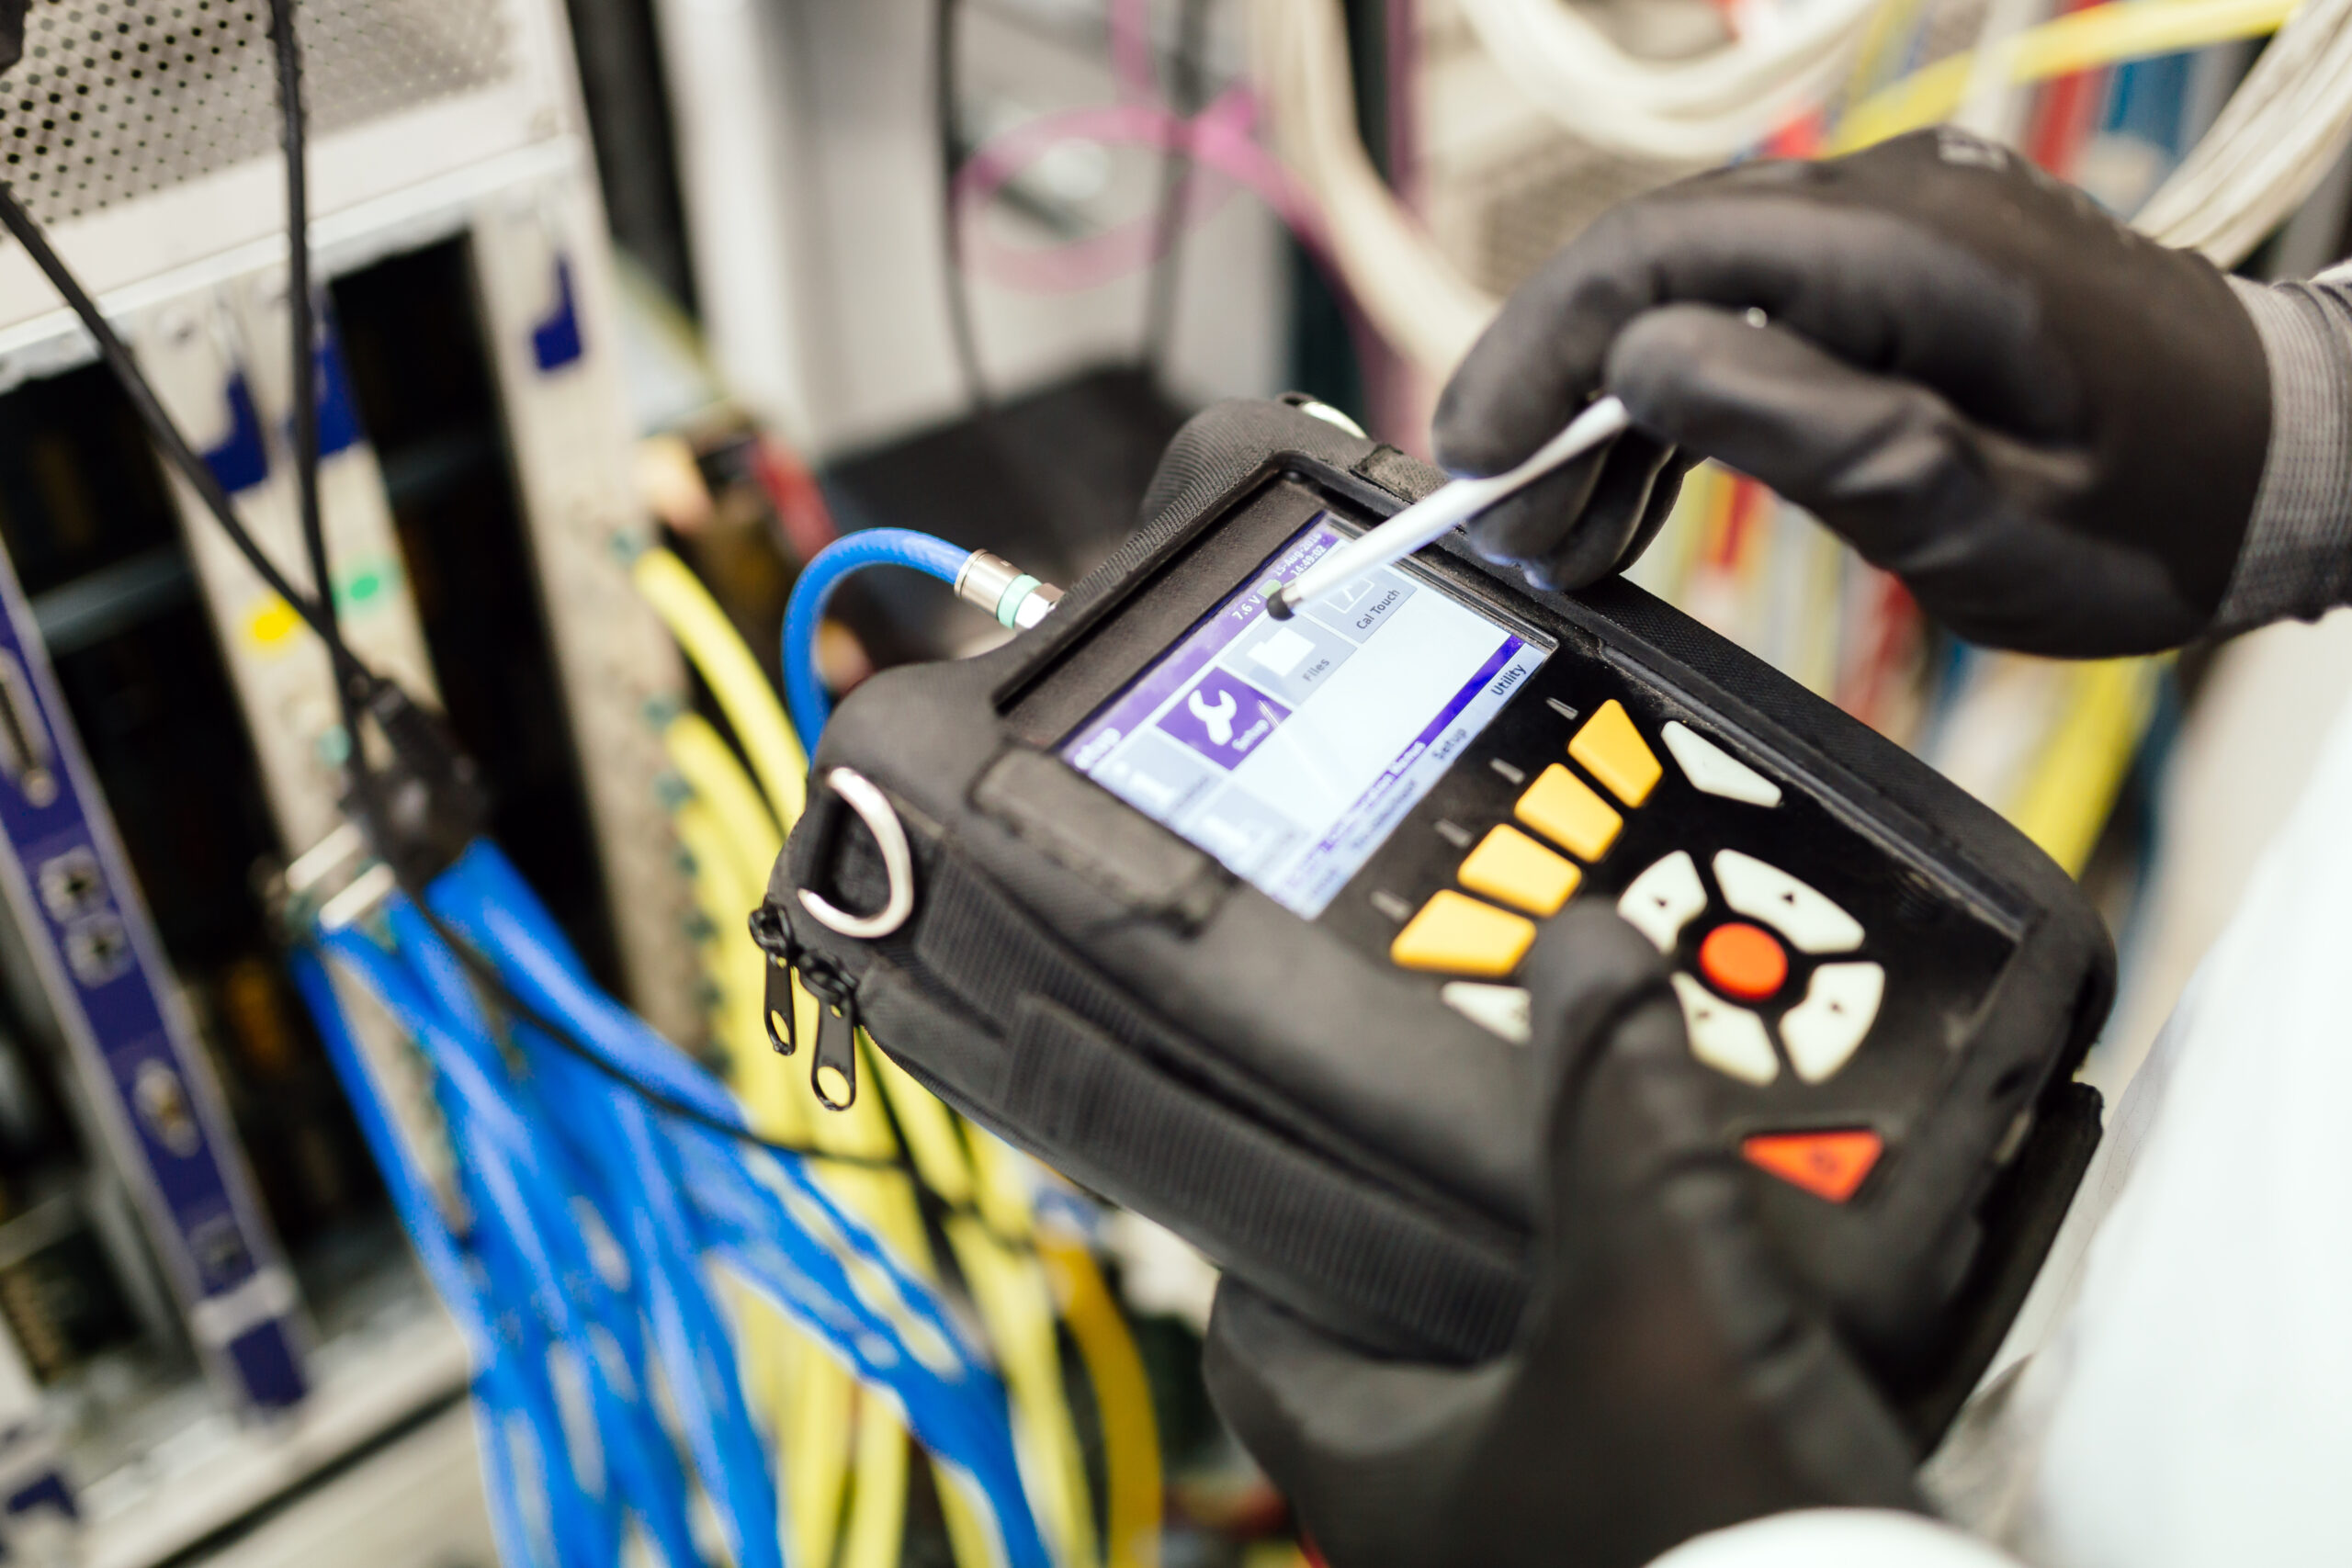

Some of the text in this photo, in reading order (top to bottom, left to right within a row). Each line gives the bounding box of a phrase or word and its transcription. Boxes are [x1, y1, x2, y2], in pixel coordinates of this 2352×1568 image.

[1290, 544, 1327, 575] 14:49:02
[1232, 594, 1261, 620] 7.6 V
[1356, 589, 1401, 629] Cal Touch
[1302, 659, 1330, 682] Files
[1490, 663, 1527, 695] Utility
[1431, 728, 1467, 761] Setup
